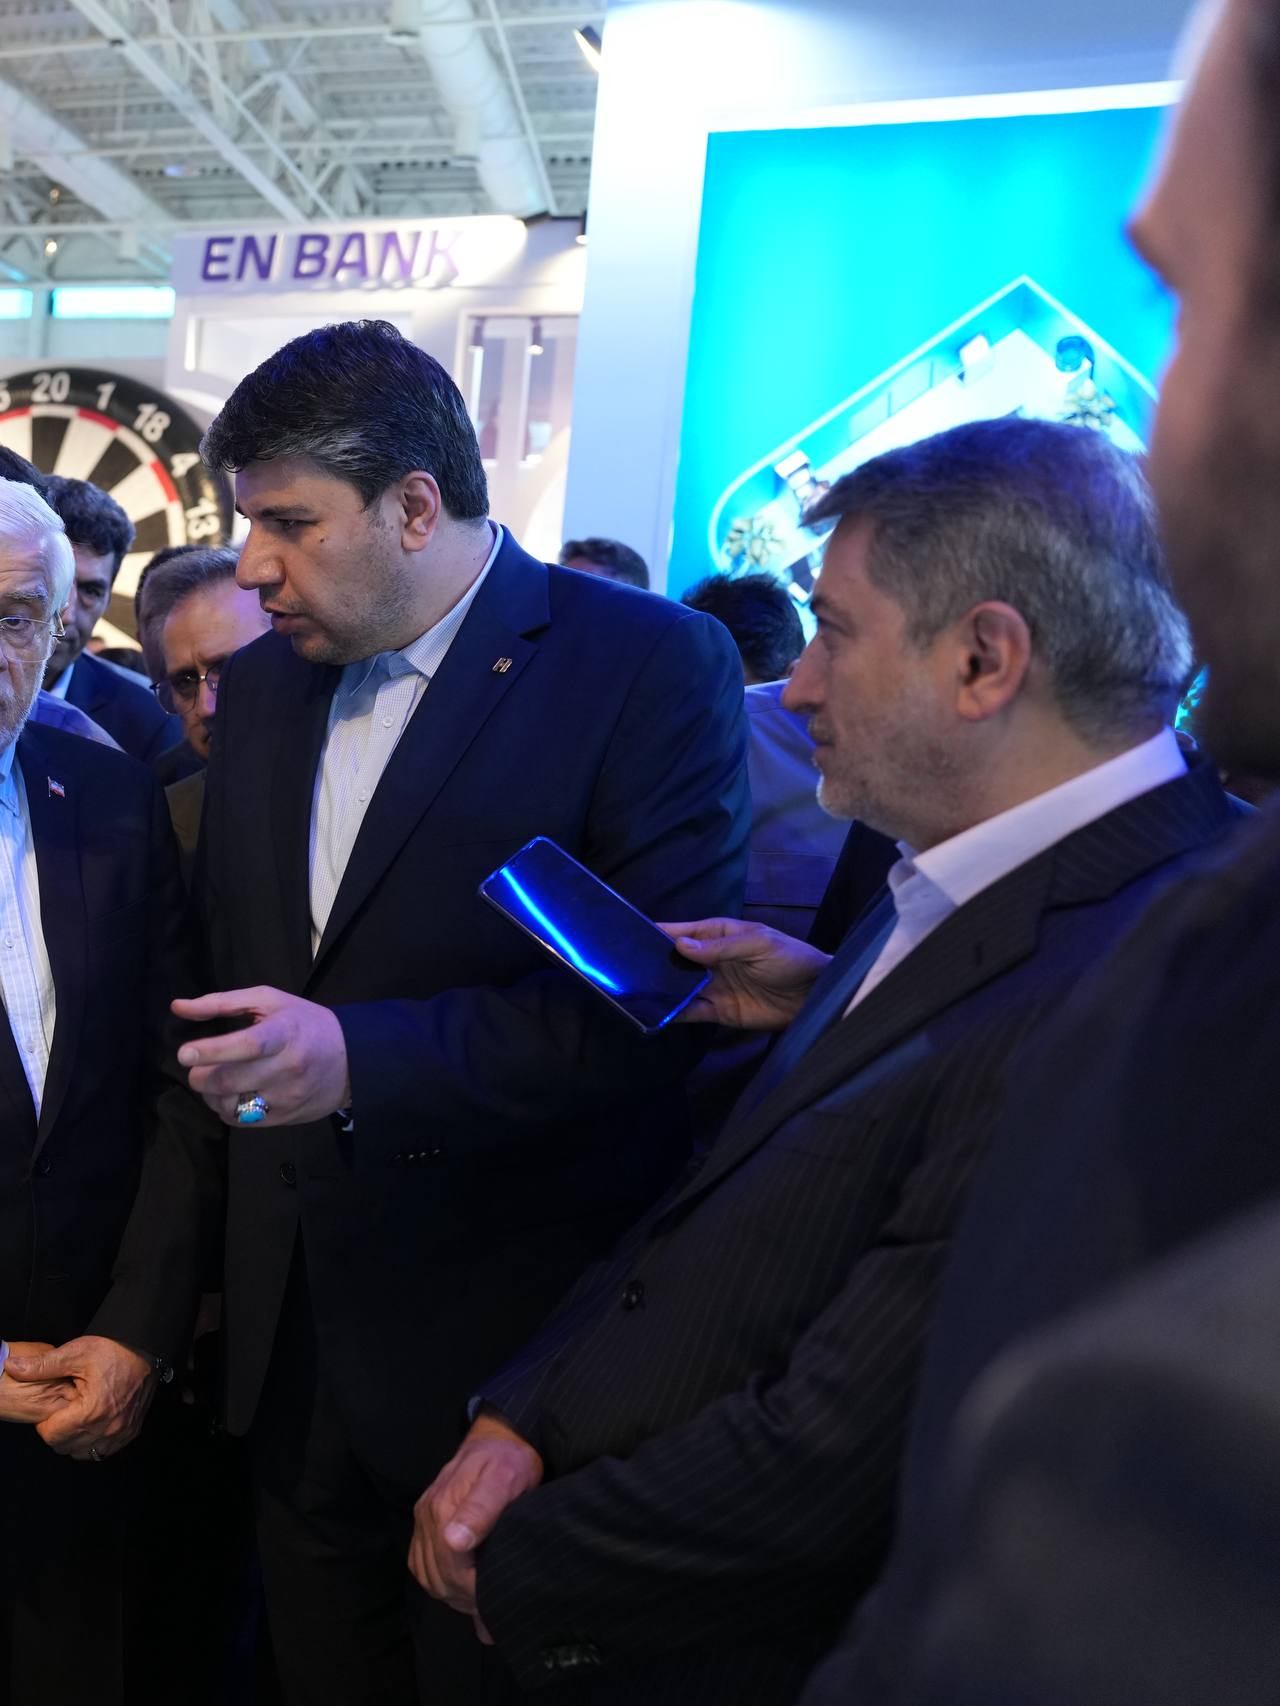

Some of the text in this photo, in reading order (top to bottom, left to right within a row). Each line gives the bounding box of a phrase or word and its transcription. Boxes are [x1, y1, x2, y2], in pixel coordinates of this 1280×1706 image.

[202, 232, 461, 282] EN BANK
[31, 371, 70, 403] 20
[96, 381, 117, 410] 1
[133, 403, 171, 442] 18
[171, 453, 200, 478] 4
[186, 497, 220, 539] 13
